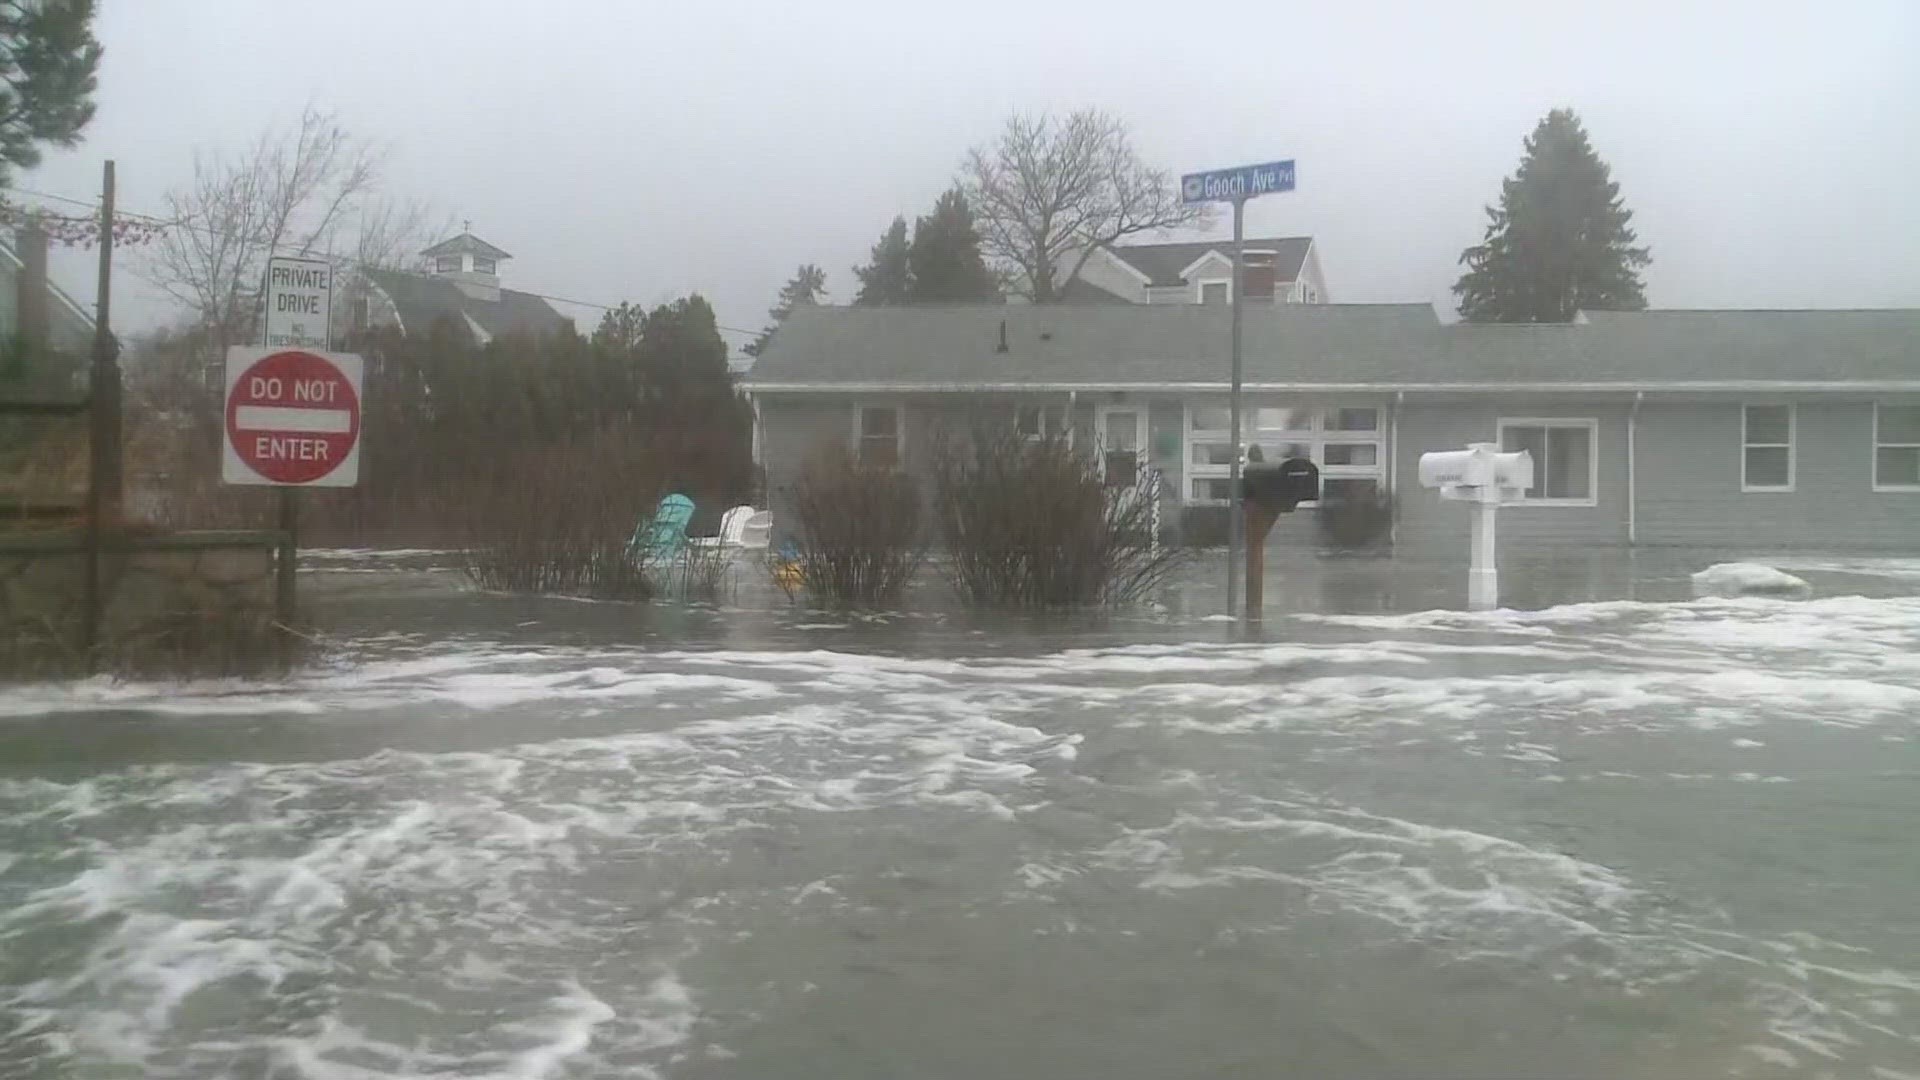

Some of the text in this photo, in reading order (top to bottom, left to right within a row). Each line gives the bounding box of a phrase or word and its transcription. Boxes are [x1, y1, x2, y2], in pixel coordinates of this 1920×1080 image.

[1204, 172, 1245, 198] Gooch
[1251, 168, 1275, 192] Ave
[272, 267, 328, 289] PRIVATE
[278, 293, 320, 314] DRIVE
[251, 376, 338, 402] DO NOT
[255, 437, 328, 460] ENTER
